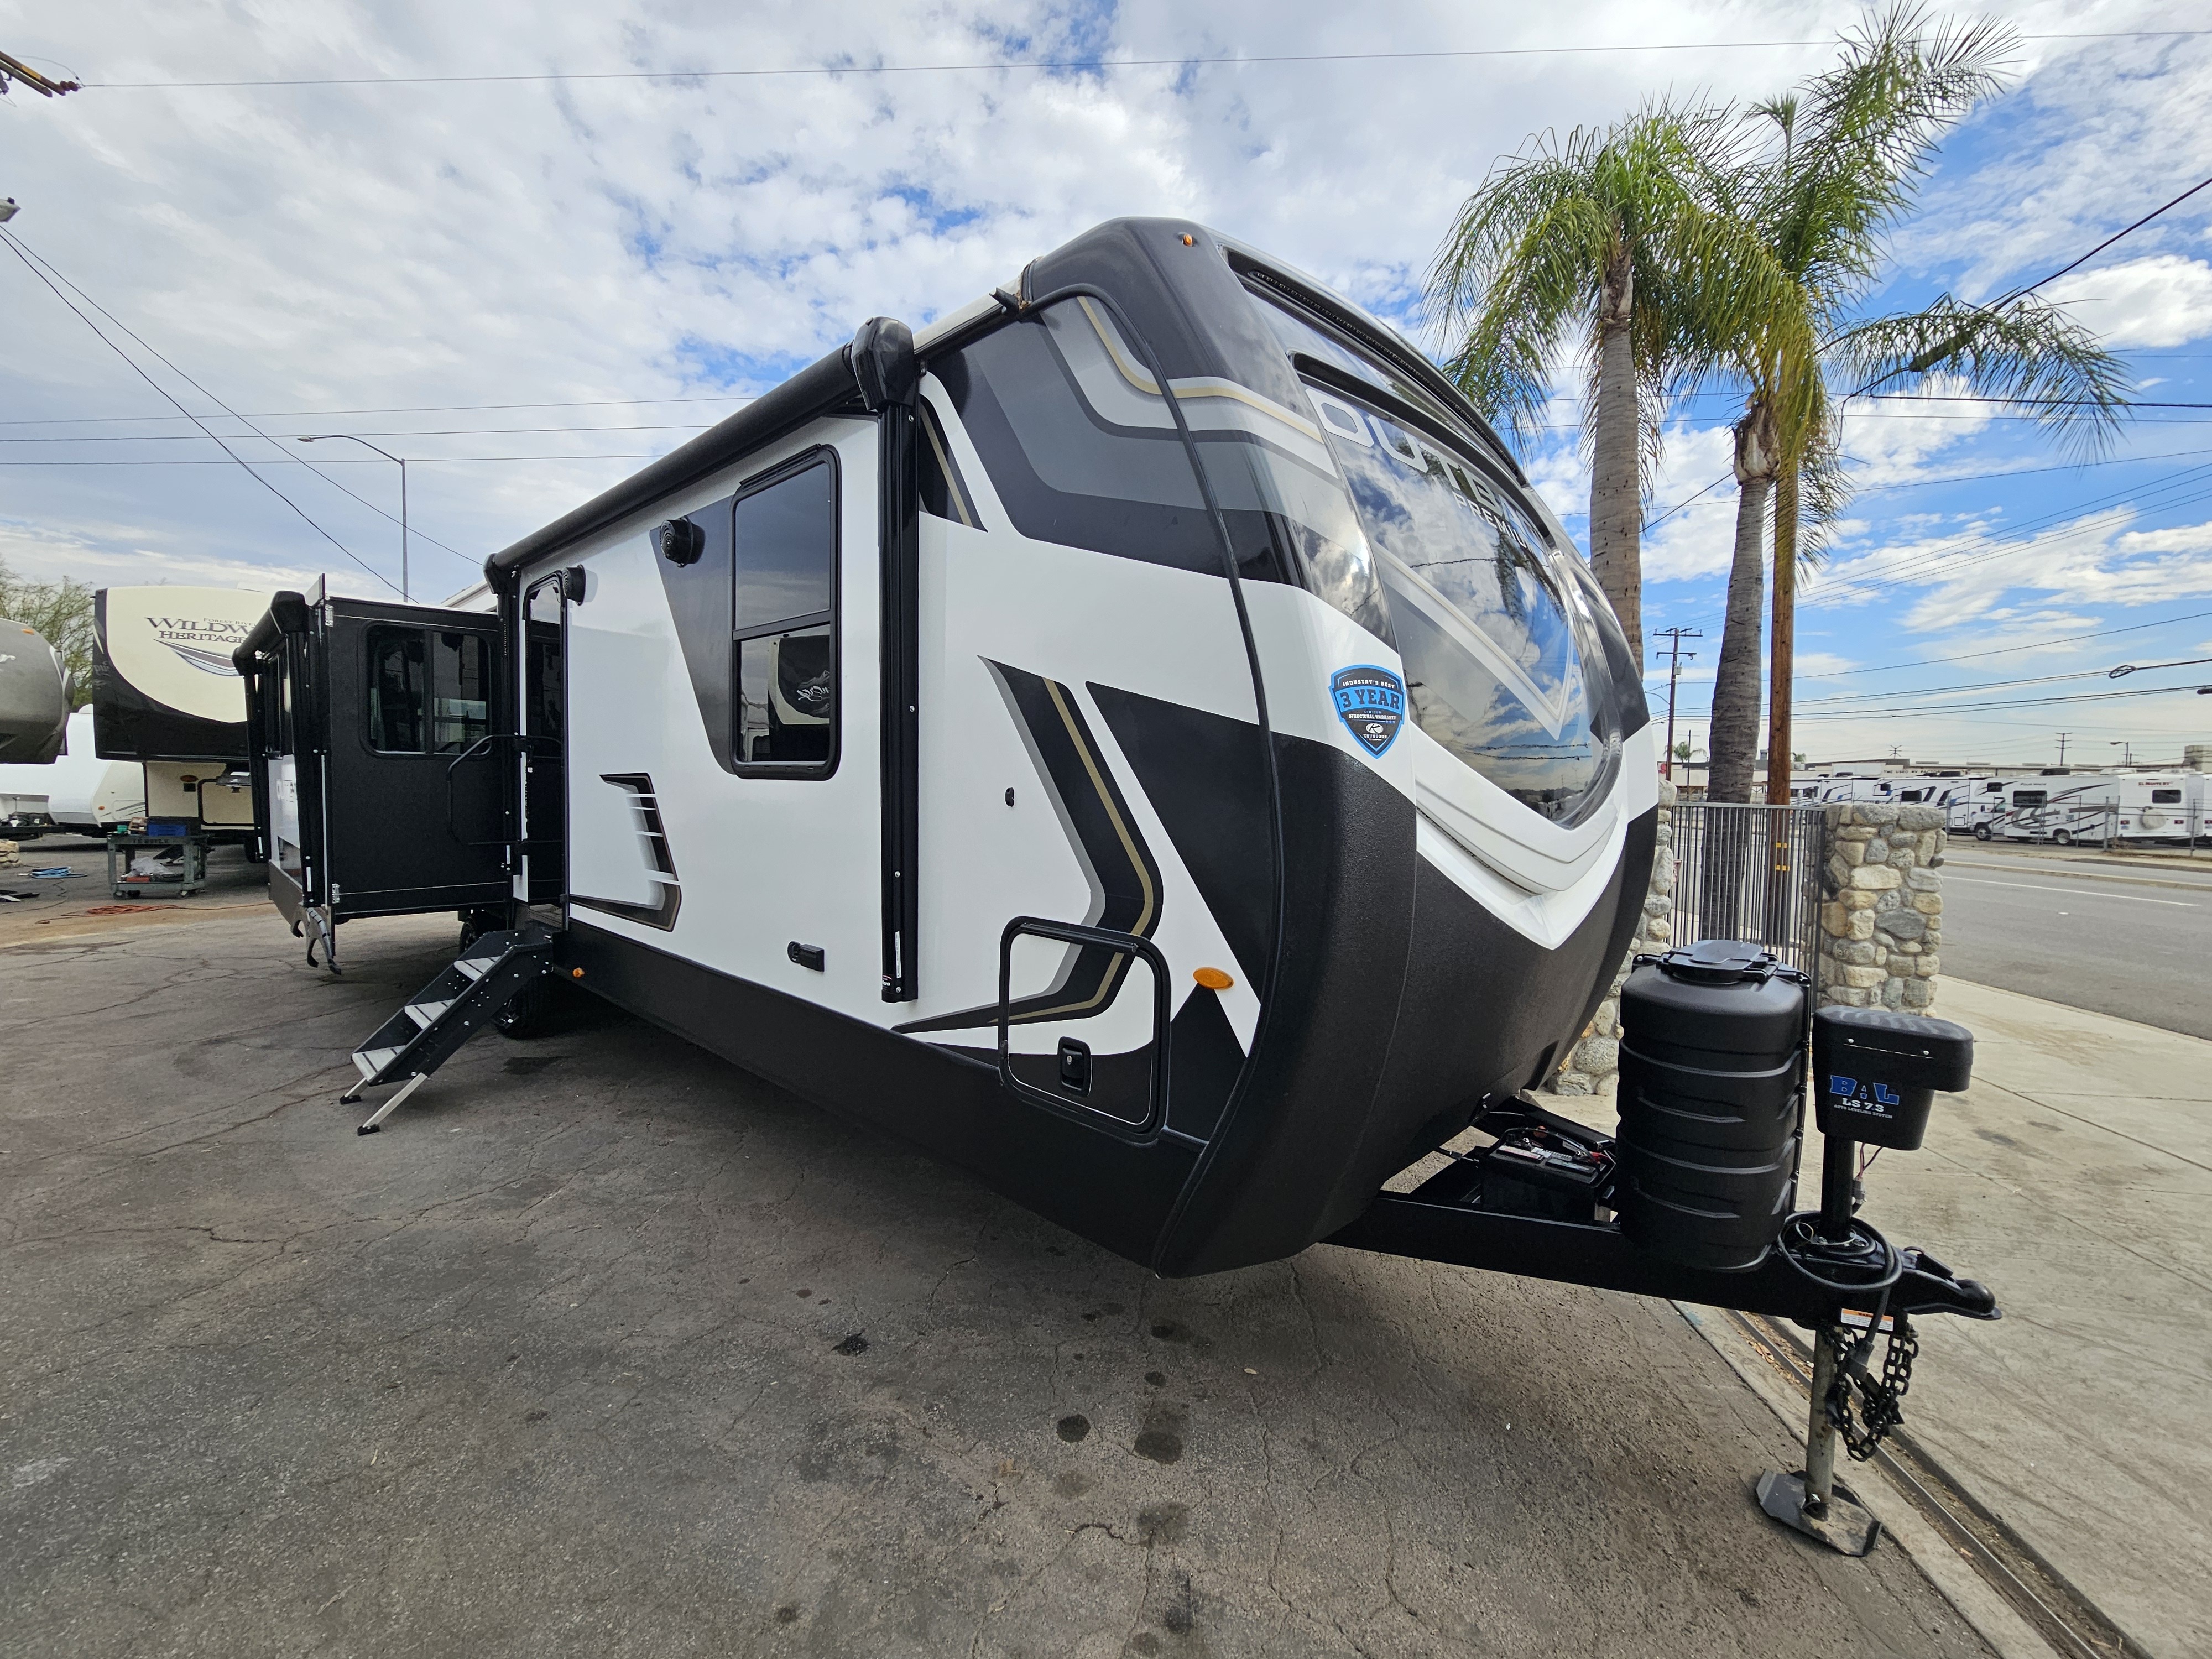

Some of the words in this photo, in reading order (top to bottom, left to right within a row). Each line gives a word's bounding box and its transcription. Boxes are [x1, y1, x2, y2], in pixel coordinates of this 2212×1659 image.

[1305, 388, 1547, 555] OUTBAC
[144, 617, 255, 635] WILDW
[1339, 691, 1352, 708] 3
[1354, 688, 1400, 710] YEAR
[1829, 1075, 1900, 1105] BAL
[1842, 1098, 1861, 1108] LS
[1864, 1102, 1884, 1112] 73
